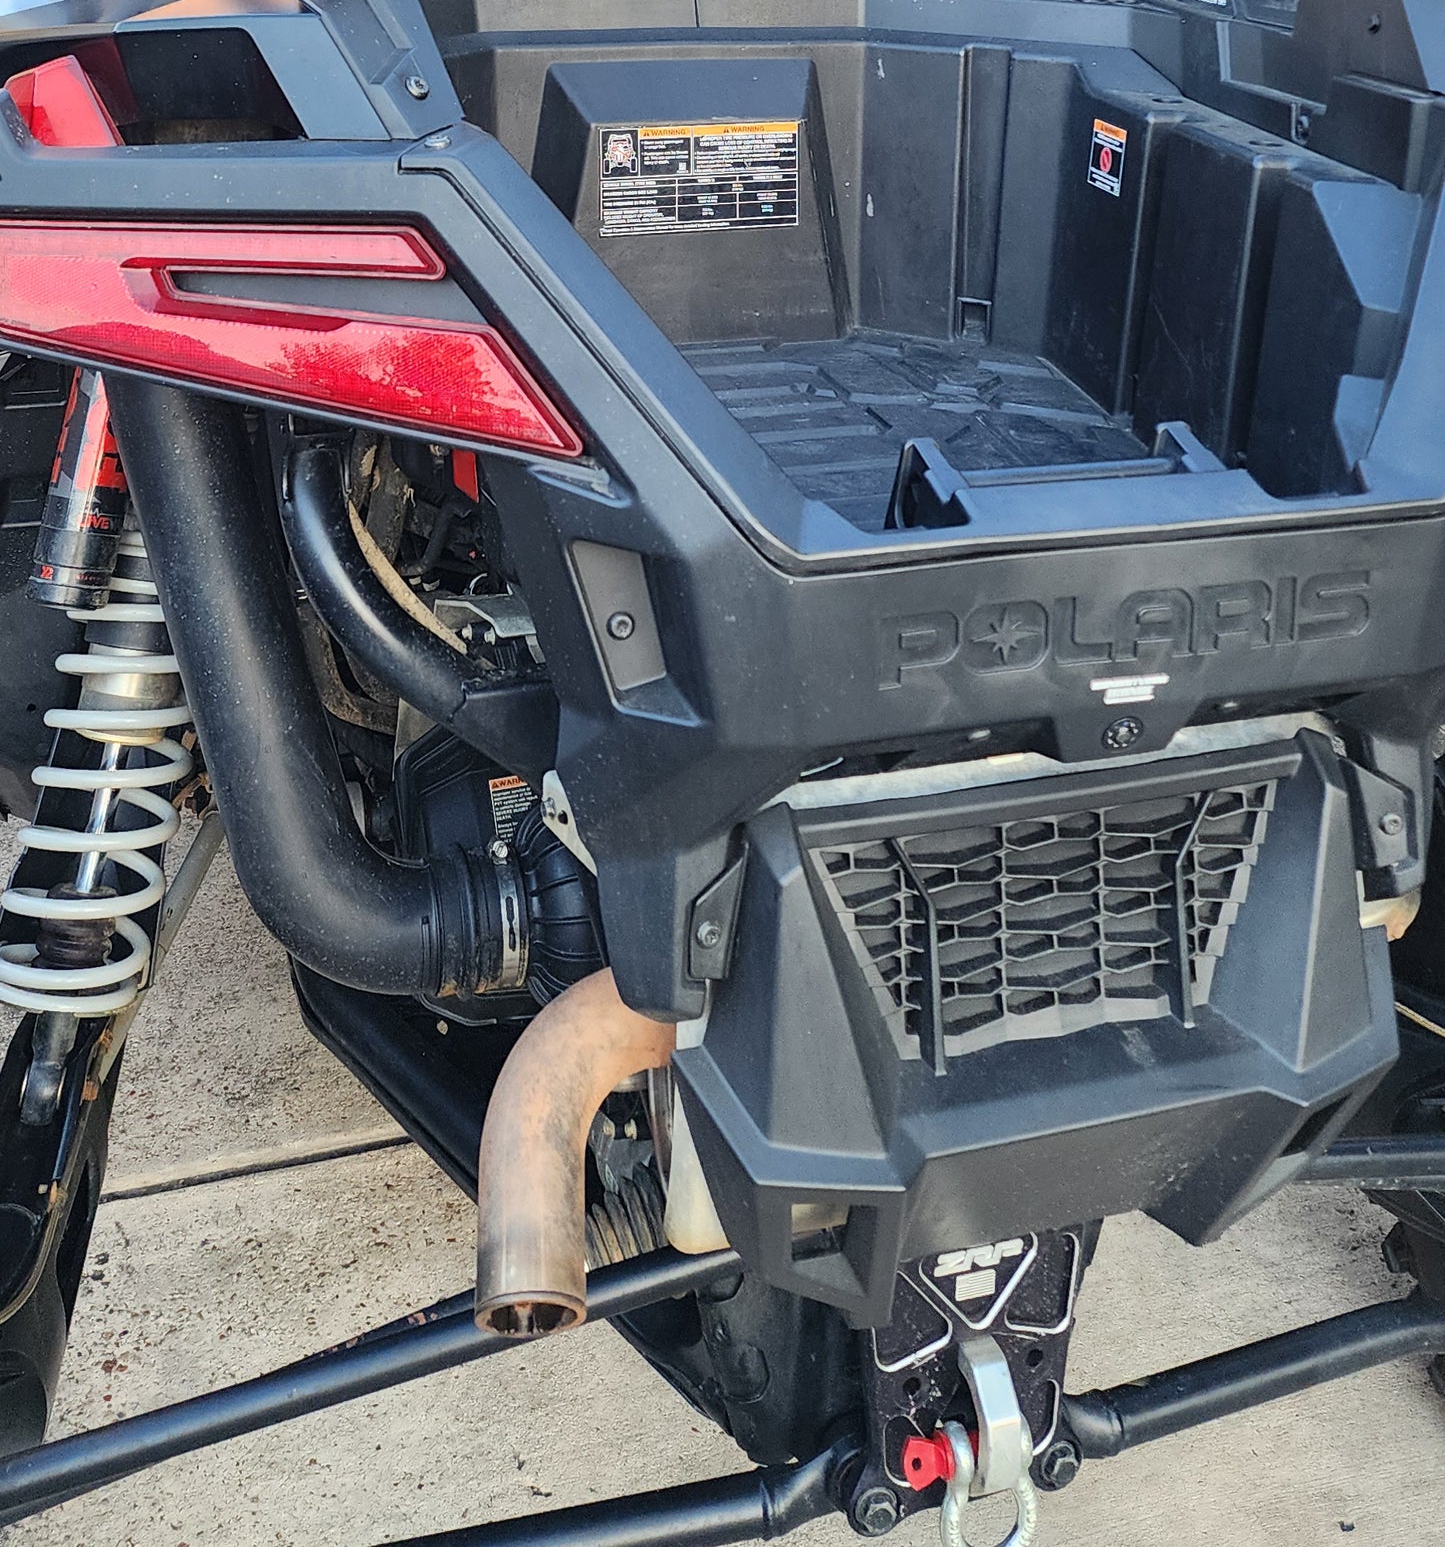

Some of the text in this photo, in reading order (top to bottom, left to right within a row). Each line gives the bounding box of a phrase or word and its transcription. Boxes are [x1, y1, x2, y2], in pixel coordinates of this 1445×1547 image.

[651, 128, 686, 137] WARNING
[731, 125, 764, 133] WARNING
[879, 570, 1370, 690] POLARIS
[933, 1237, 1025, 1278] ZRP
